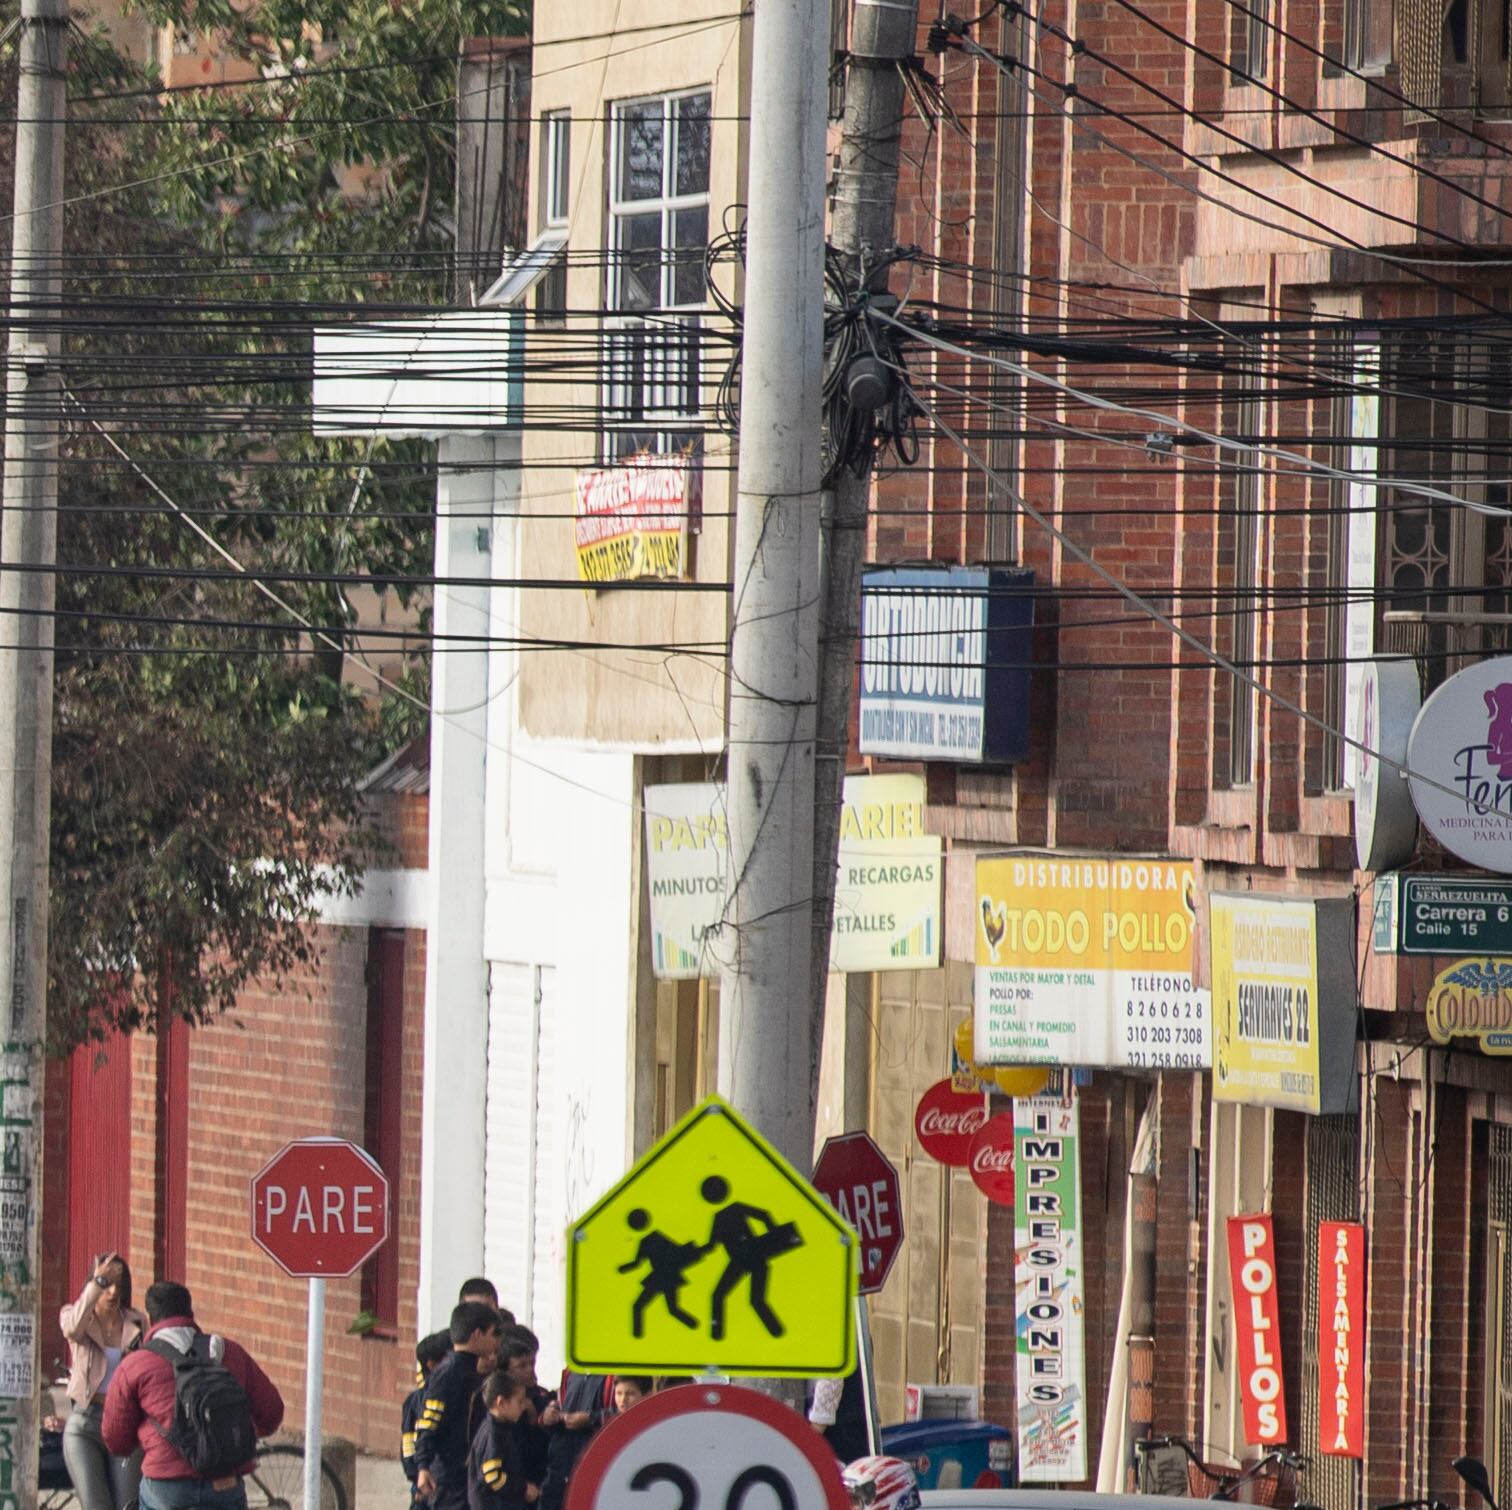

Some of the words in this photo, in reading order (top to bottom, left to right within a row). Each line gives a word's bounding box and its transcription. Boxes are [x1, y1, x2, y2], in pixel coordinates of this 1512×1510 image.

[863, 588, 983, 699] ORTODONCIA
[1439, 817, 1502, 829] MEDICINA
[1473, 830, 1505, 841] PARA
[653, 876, 726, 897] MINUTOS
[848, 865, 934, 885] RECARGAS
[1013, 863, 1178, 890] DISTRIBUIDORA
[1416, 890, 1508, 902] SERREZUELITA
[1416, 904, 1486, 921] Carrera
[1497, 904, 1509, 922] 6
[1006, 908, 1090, 955] TODO
[1103, 910, 1188, 953] POLLO
[1416, 923, 1451, 935] Calle
[1460, 923, 1477, 935] 15
[990, 972, 1018, 984] VENTAS
[1019, 973, 1036, 984] POR
[1037, 974, 1065, 985] MAYOR
[990, 988, 1013, 1000] POLLO
[990, 1004, 1016, 1016] PRESAS
[1296, 988, 1310, 1043] 22
[990, 1021, 1001, 1032] EN
[1002, 1021, 1027, 1033] CANAL
[1036, 1022, 1076, 1033] PROMEDIO
[1127, 1026, 1148, 1042] 310
[1151, 1027, 1171, 1043] 203
[1175, 1028, 1202, 1044] 7308
[990, 1037, 1049, 1049] SALSAMENTARIA
[1127, 1053, 1147, 1067] 321
[1151, 1053, 1171, 1067] 258
[265, 1185, 375, 1235] PARE
[822, 1180, 893, 1242] ARE
[1022, 1112, 1064, 1406] IMPRESIONES
[1240, 1223, 1281, 1438] POLLOS
[1333, 1229, 1351, 1451] SALSAMENTARIA
